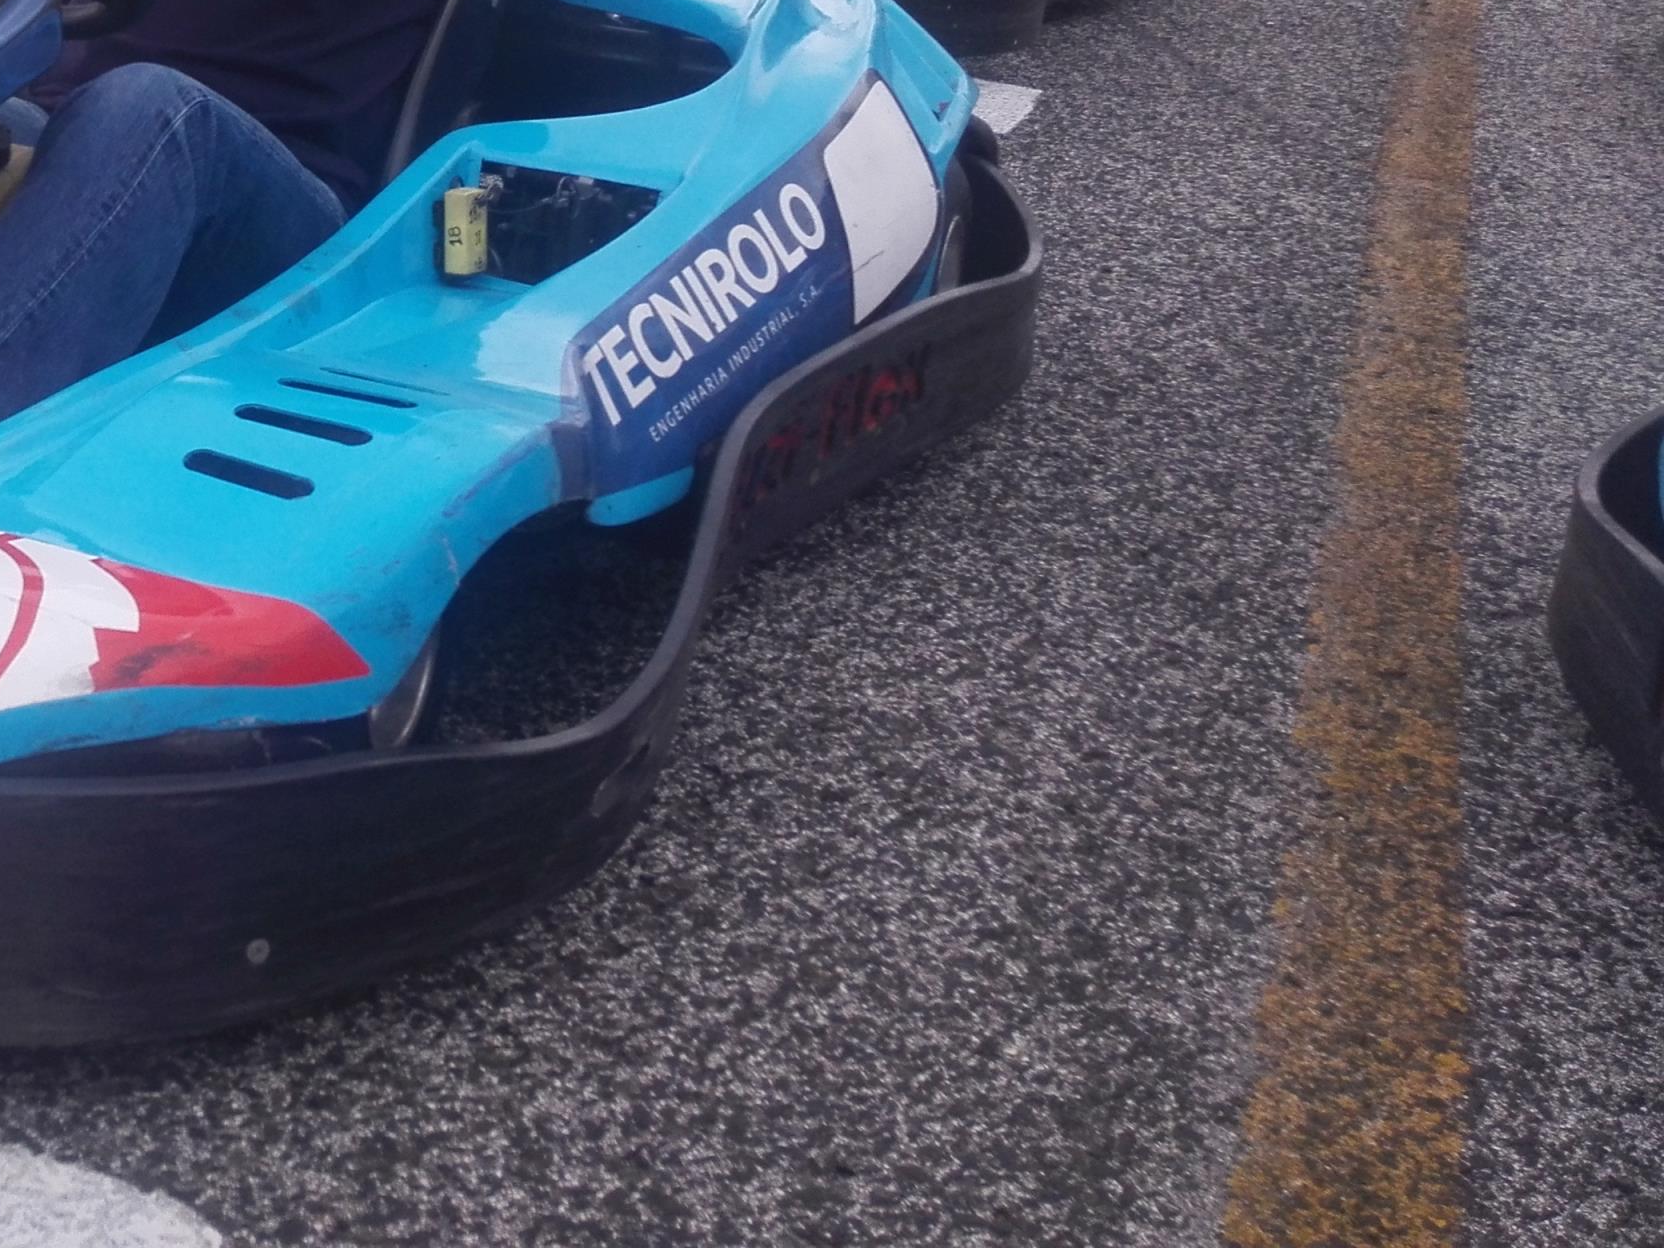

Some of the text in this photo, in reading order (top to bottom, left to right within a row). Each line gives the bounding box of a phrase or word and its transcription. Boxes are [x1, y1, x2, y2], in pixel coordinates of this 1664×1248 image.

[581, 182, 826, 427] TECNIROLO
[648, 367, 729, 443] ENGENHARIA
[799, 285, 822, 308] S.A.
